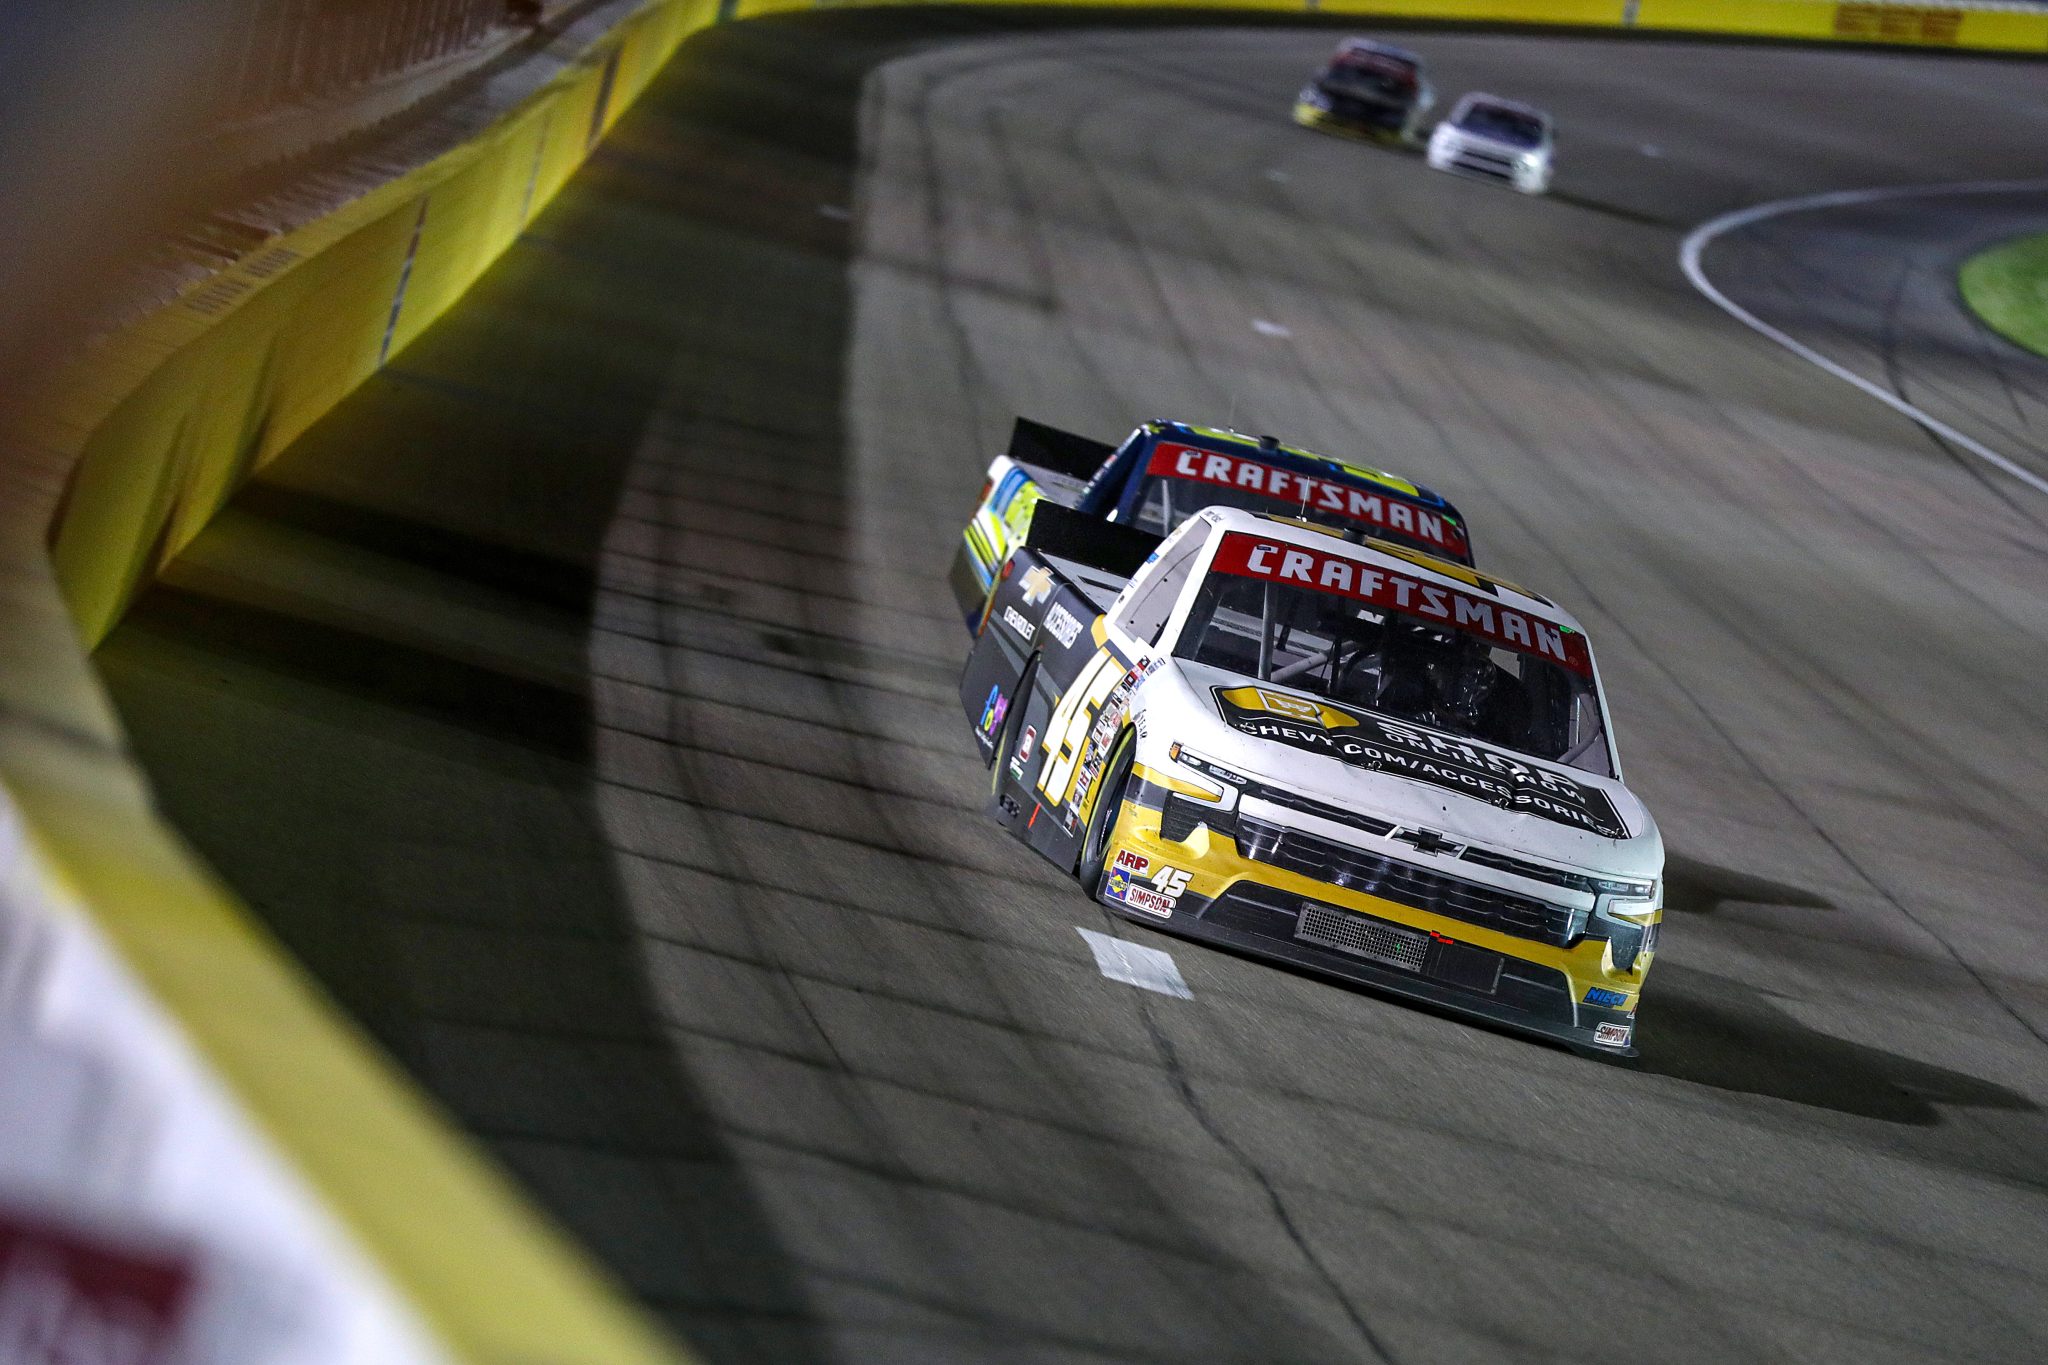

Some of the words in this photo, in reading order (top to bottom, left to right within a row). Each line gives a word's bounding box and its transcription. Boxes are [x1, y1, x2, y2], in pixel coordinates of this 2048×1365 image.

[1175, 451, 1443, 544] CRAFTSMAN
[1247, 544, 1567, 661] CRAFTSMAN
[1377, 722, 1580, 790] SHOP
[1386, 733, 1506, 775] ONLINE
[1516, 774, 1586, 804] NOW
[1115, 849, 1149, 871] ARP
[1150, 864, 1195, 898] 45
[1129, 887, 1171, 913] SIMPSON
